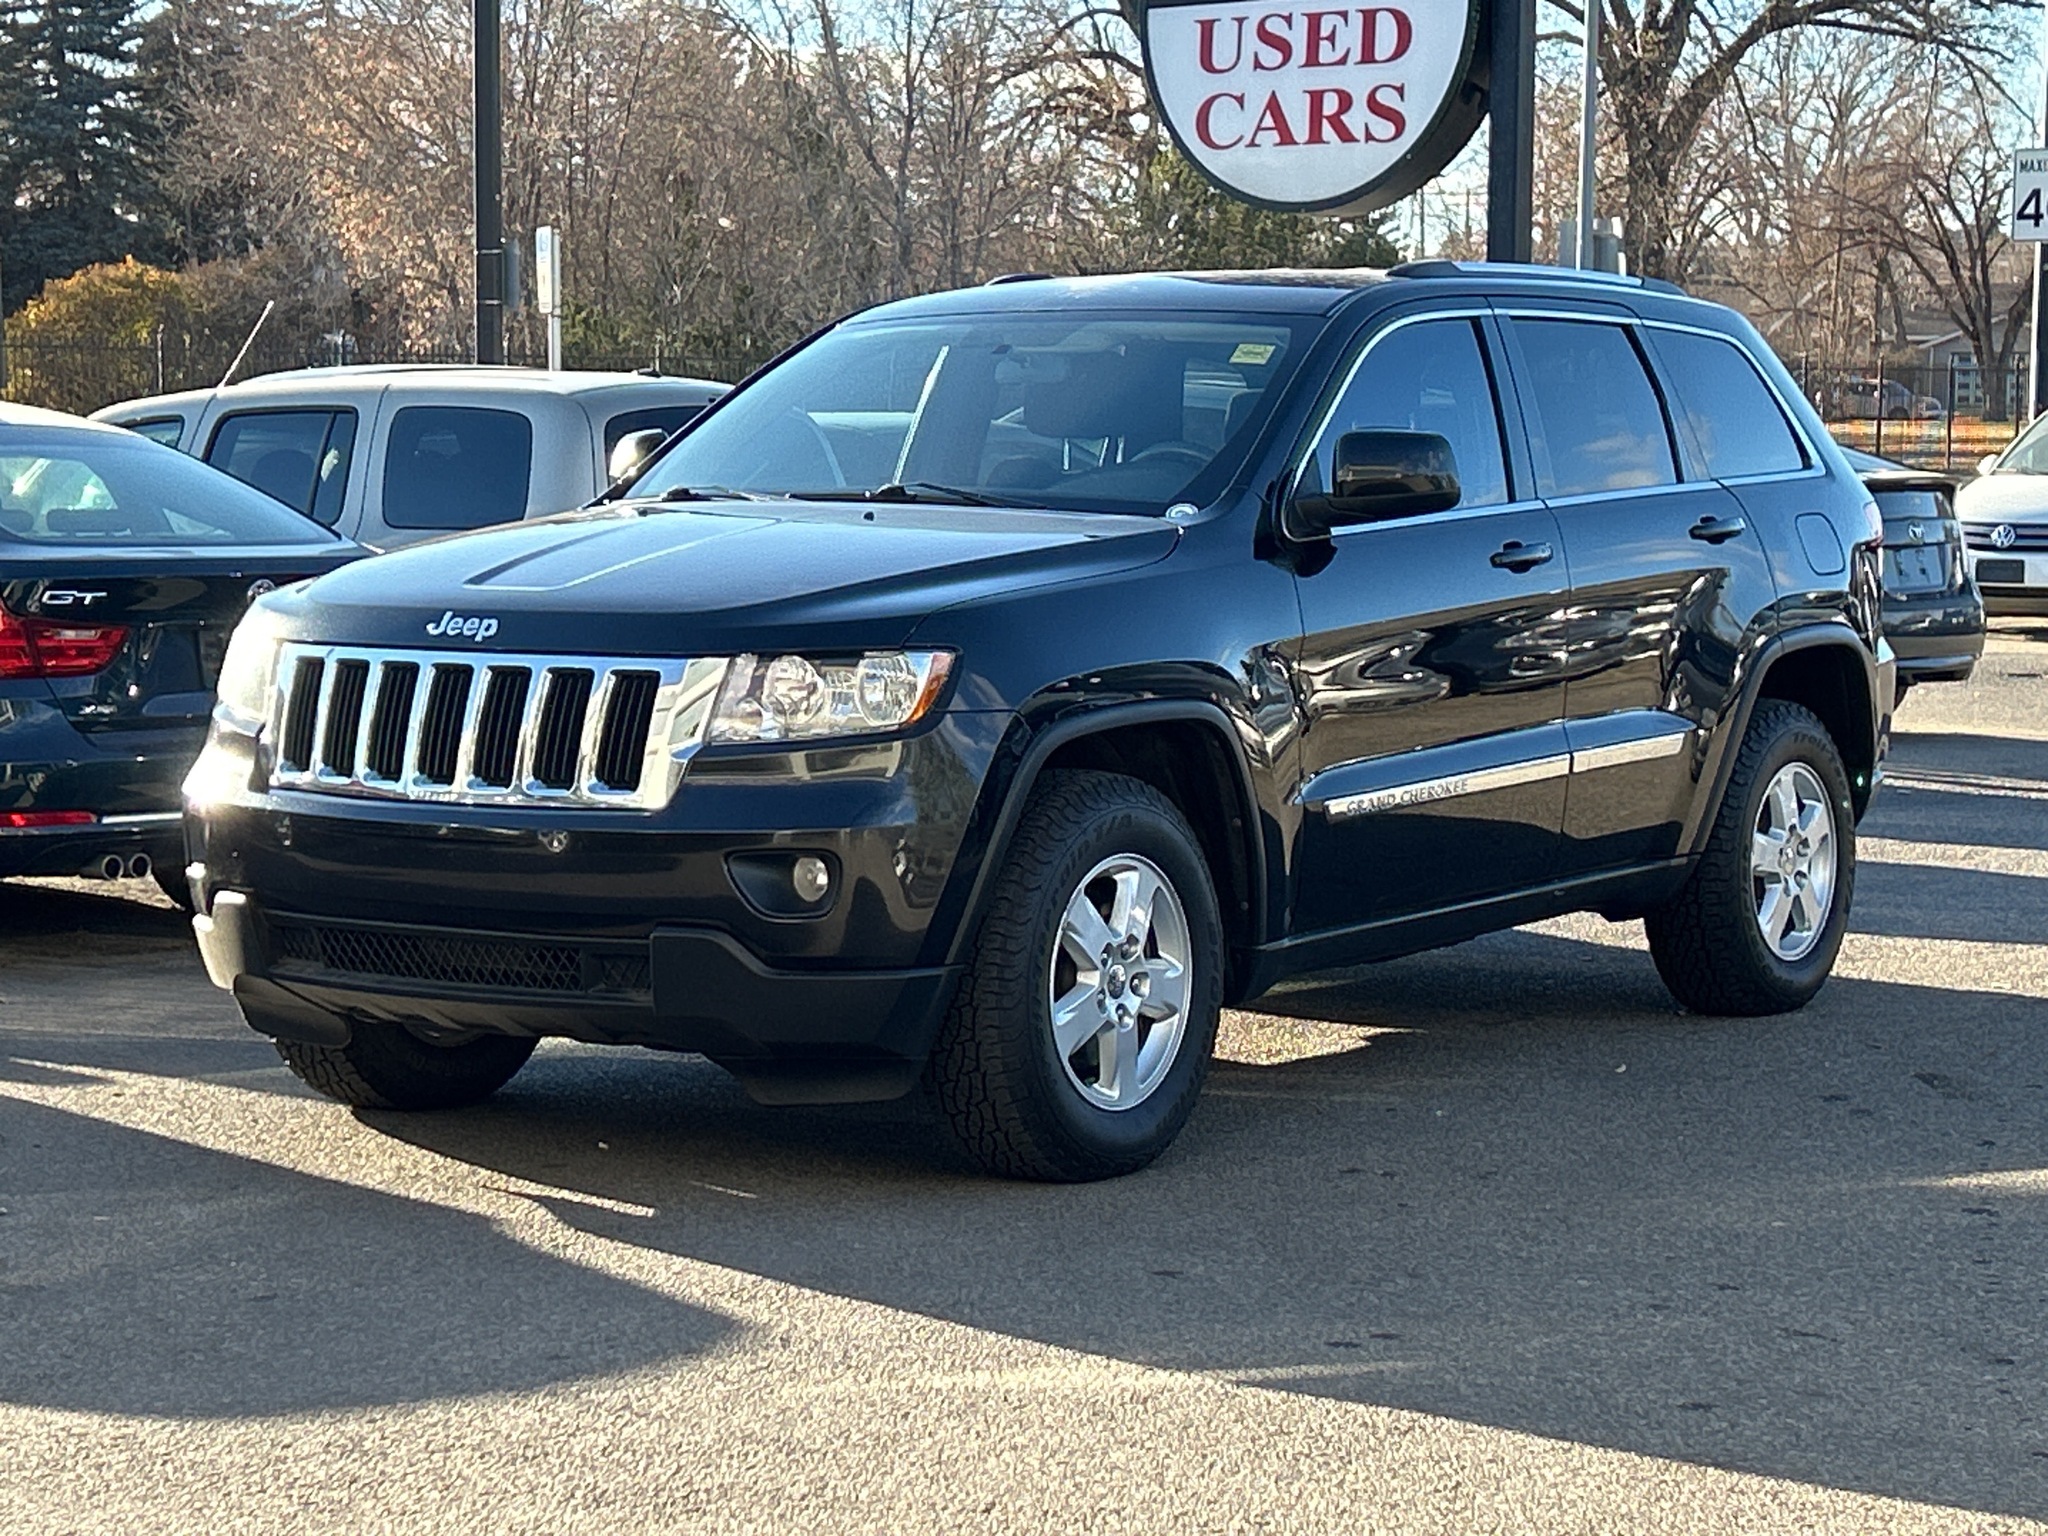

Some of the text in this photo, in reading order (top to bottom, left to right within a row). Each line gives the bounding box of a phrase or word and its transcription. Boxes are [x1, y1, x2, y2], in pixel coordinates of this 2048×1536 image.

[1193, 7, 1414, 75] USED
[1194, 82, 1408, 151] CARS
[2016, 187, 2048, 228] 4
[41, 590, 108, 605] GT
[425, 610, 499, 642] Jeep
[1346, 778, 1469, 816] GRAND CHEROKEE
